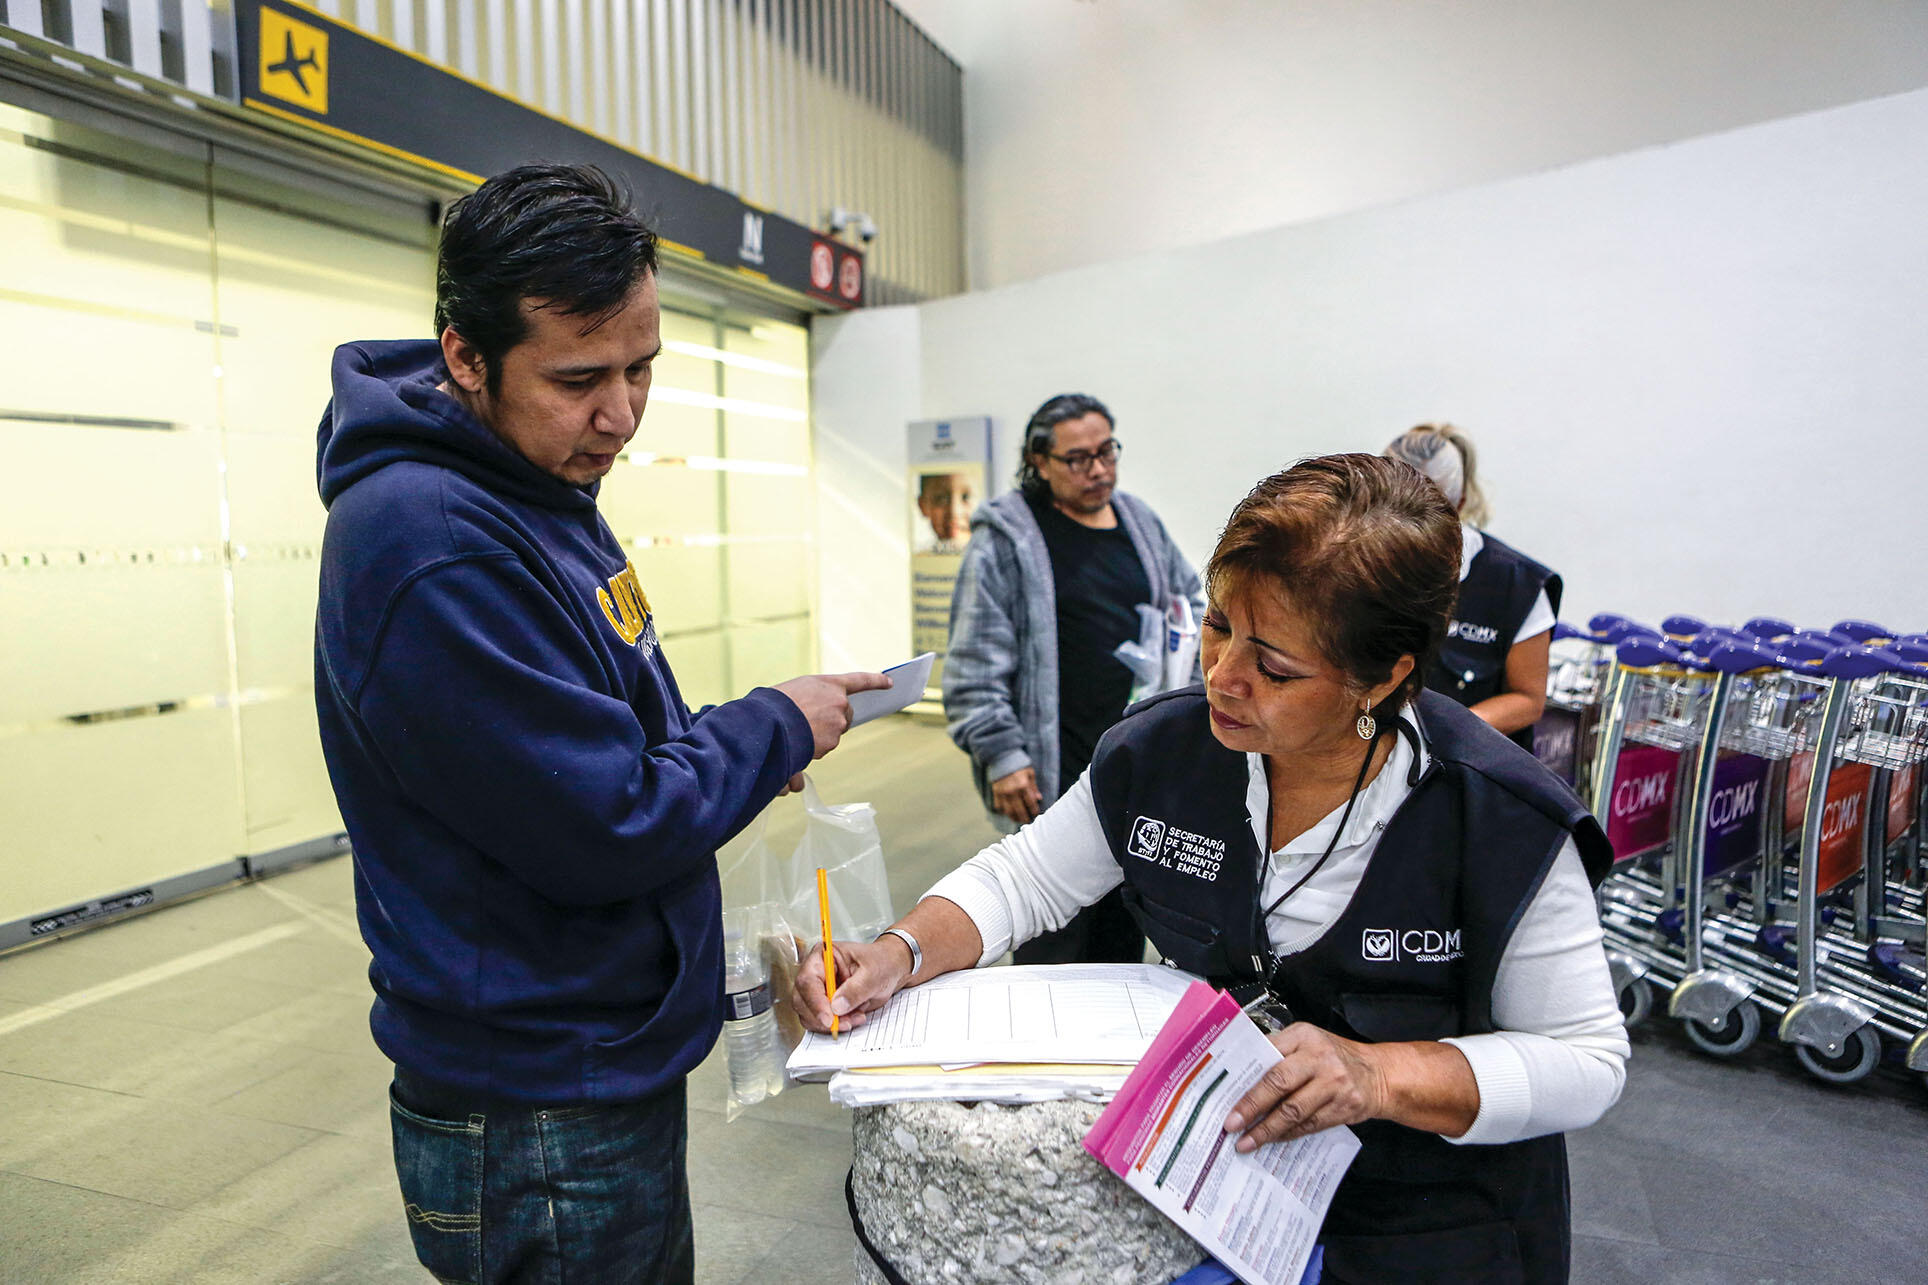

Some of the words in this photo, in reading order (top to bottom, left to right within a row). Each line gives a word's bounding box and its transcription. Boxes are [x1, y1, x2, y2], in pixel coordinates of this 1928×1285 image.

[1614, 770, 1670, 817] CDMX
[1709, 780, 1759, 829] CDMX
[1821, 792, 1862, 842] CDMX
[1163, 845, 1171, 856] Y
[1173, 850, 1221, 872] FOMENTO
[1165, 836, 1180, 848] DE
[1181, 841, 1224, 862] TRABAJO
[1159, 856, 1173, 869] AL
[1176, 862, 1217, 882] EMPLEO
[1402, 928, 1461, 954] CDM
